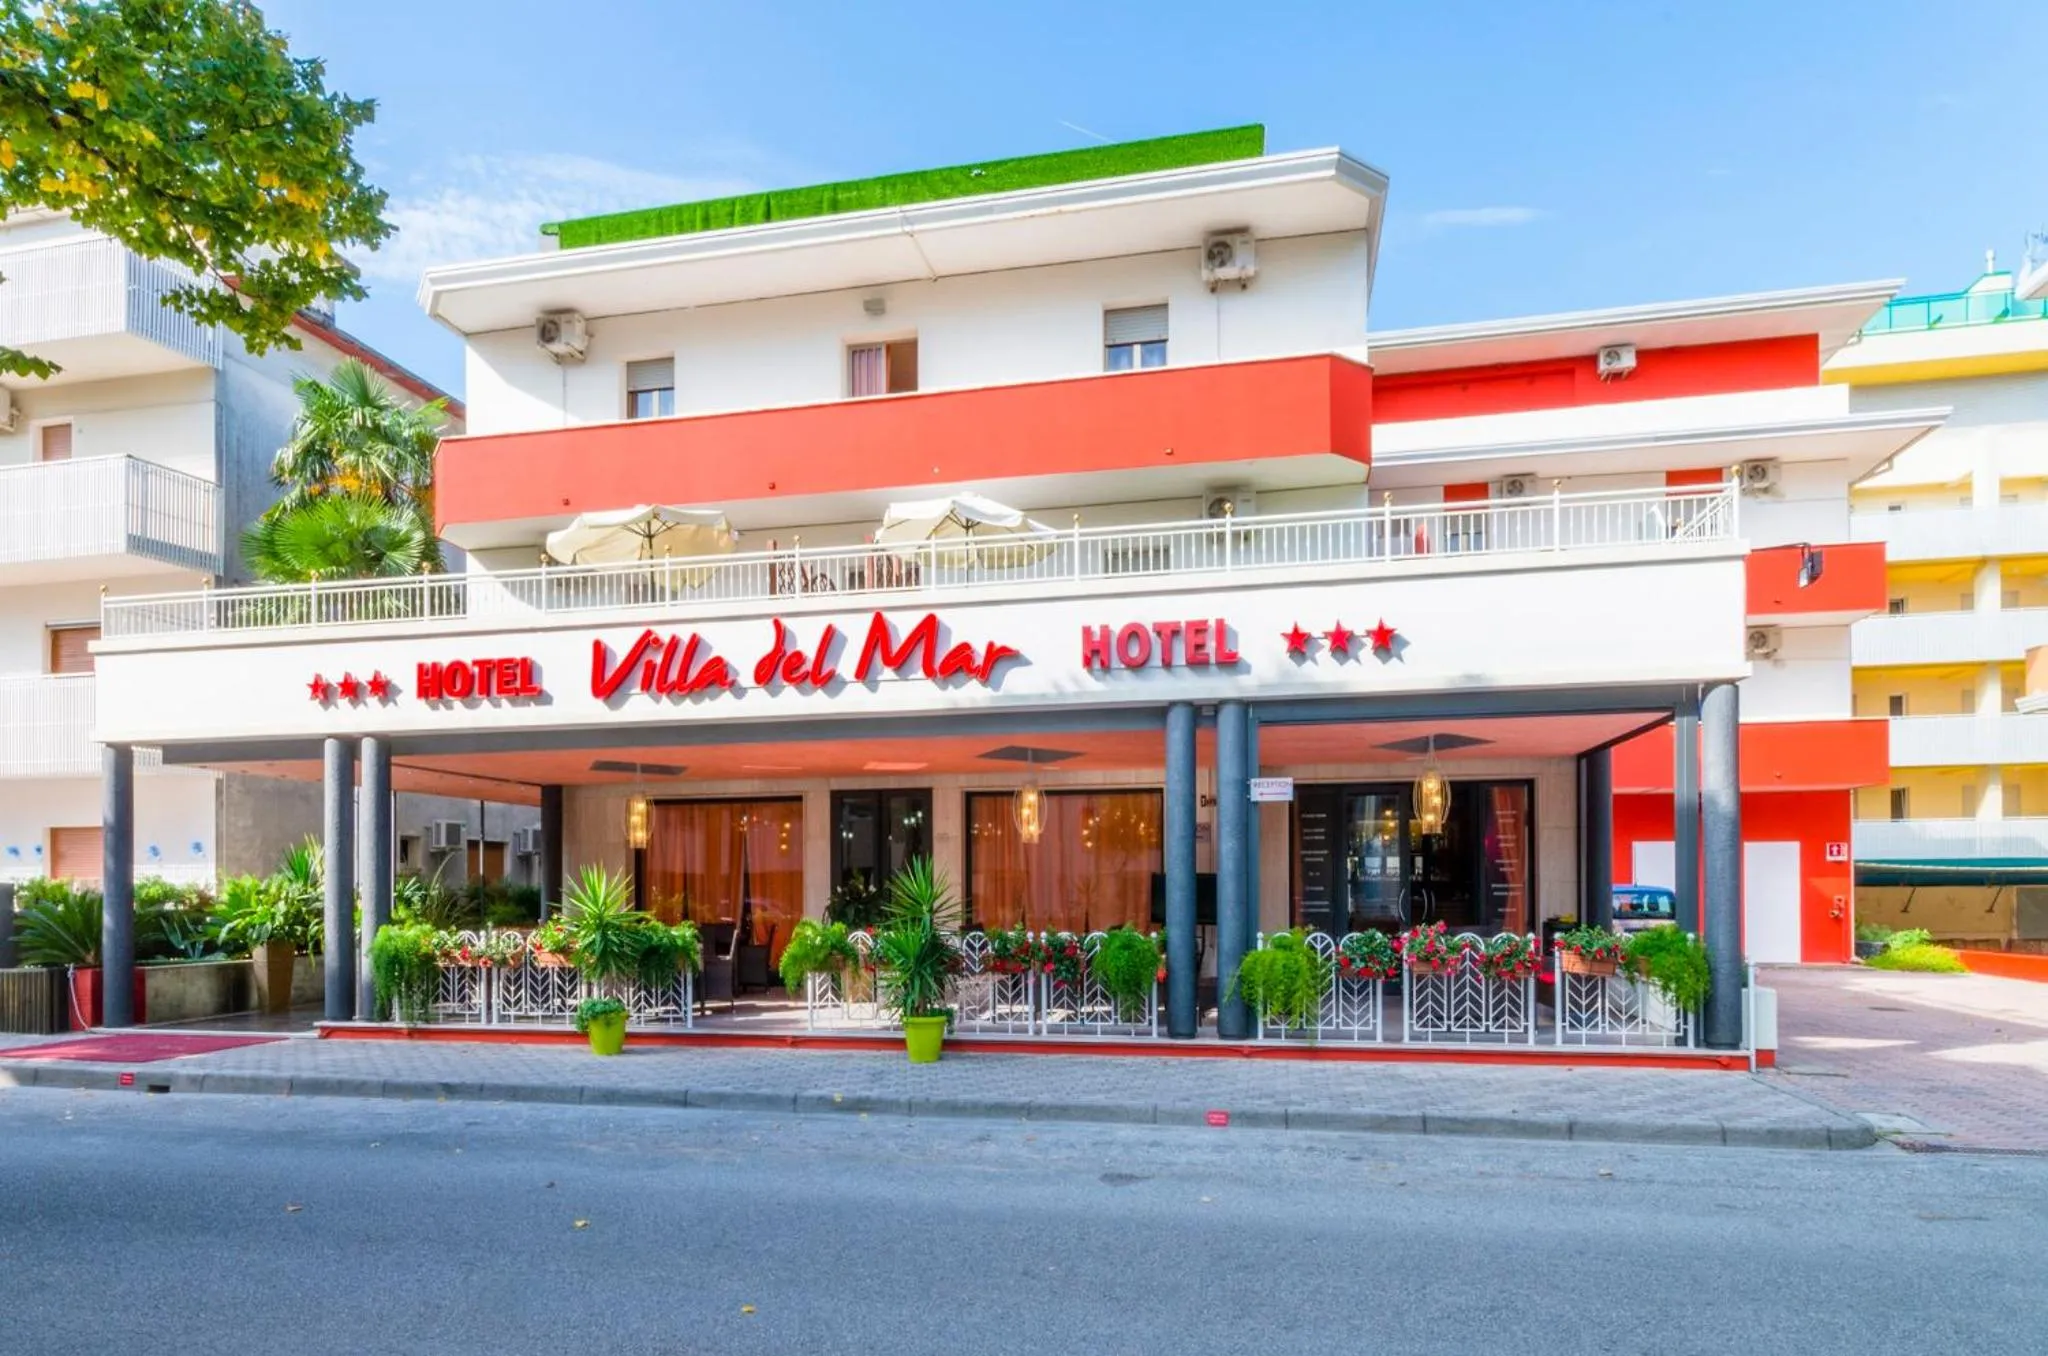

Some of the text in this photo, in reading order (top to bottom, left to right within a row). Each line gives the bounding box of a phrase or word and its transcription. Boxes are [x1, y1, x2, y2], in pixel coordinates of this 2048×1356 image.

[416, 610, 1239, 702] HOTEL Villa del Mar HOTEL
